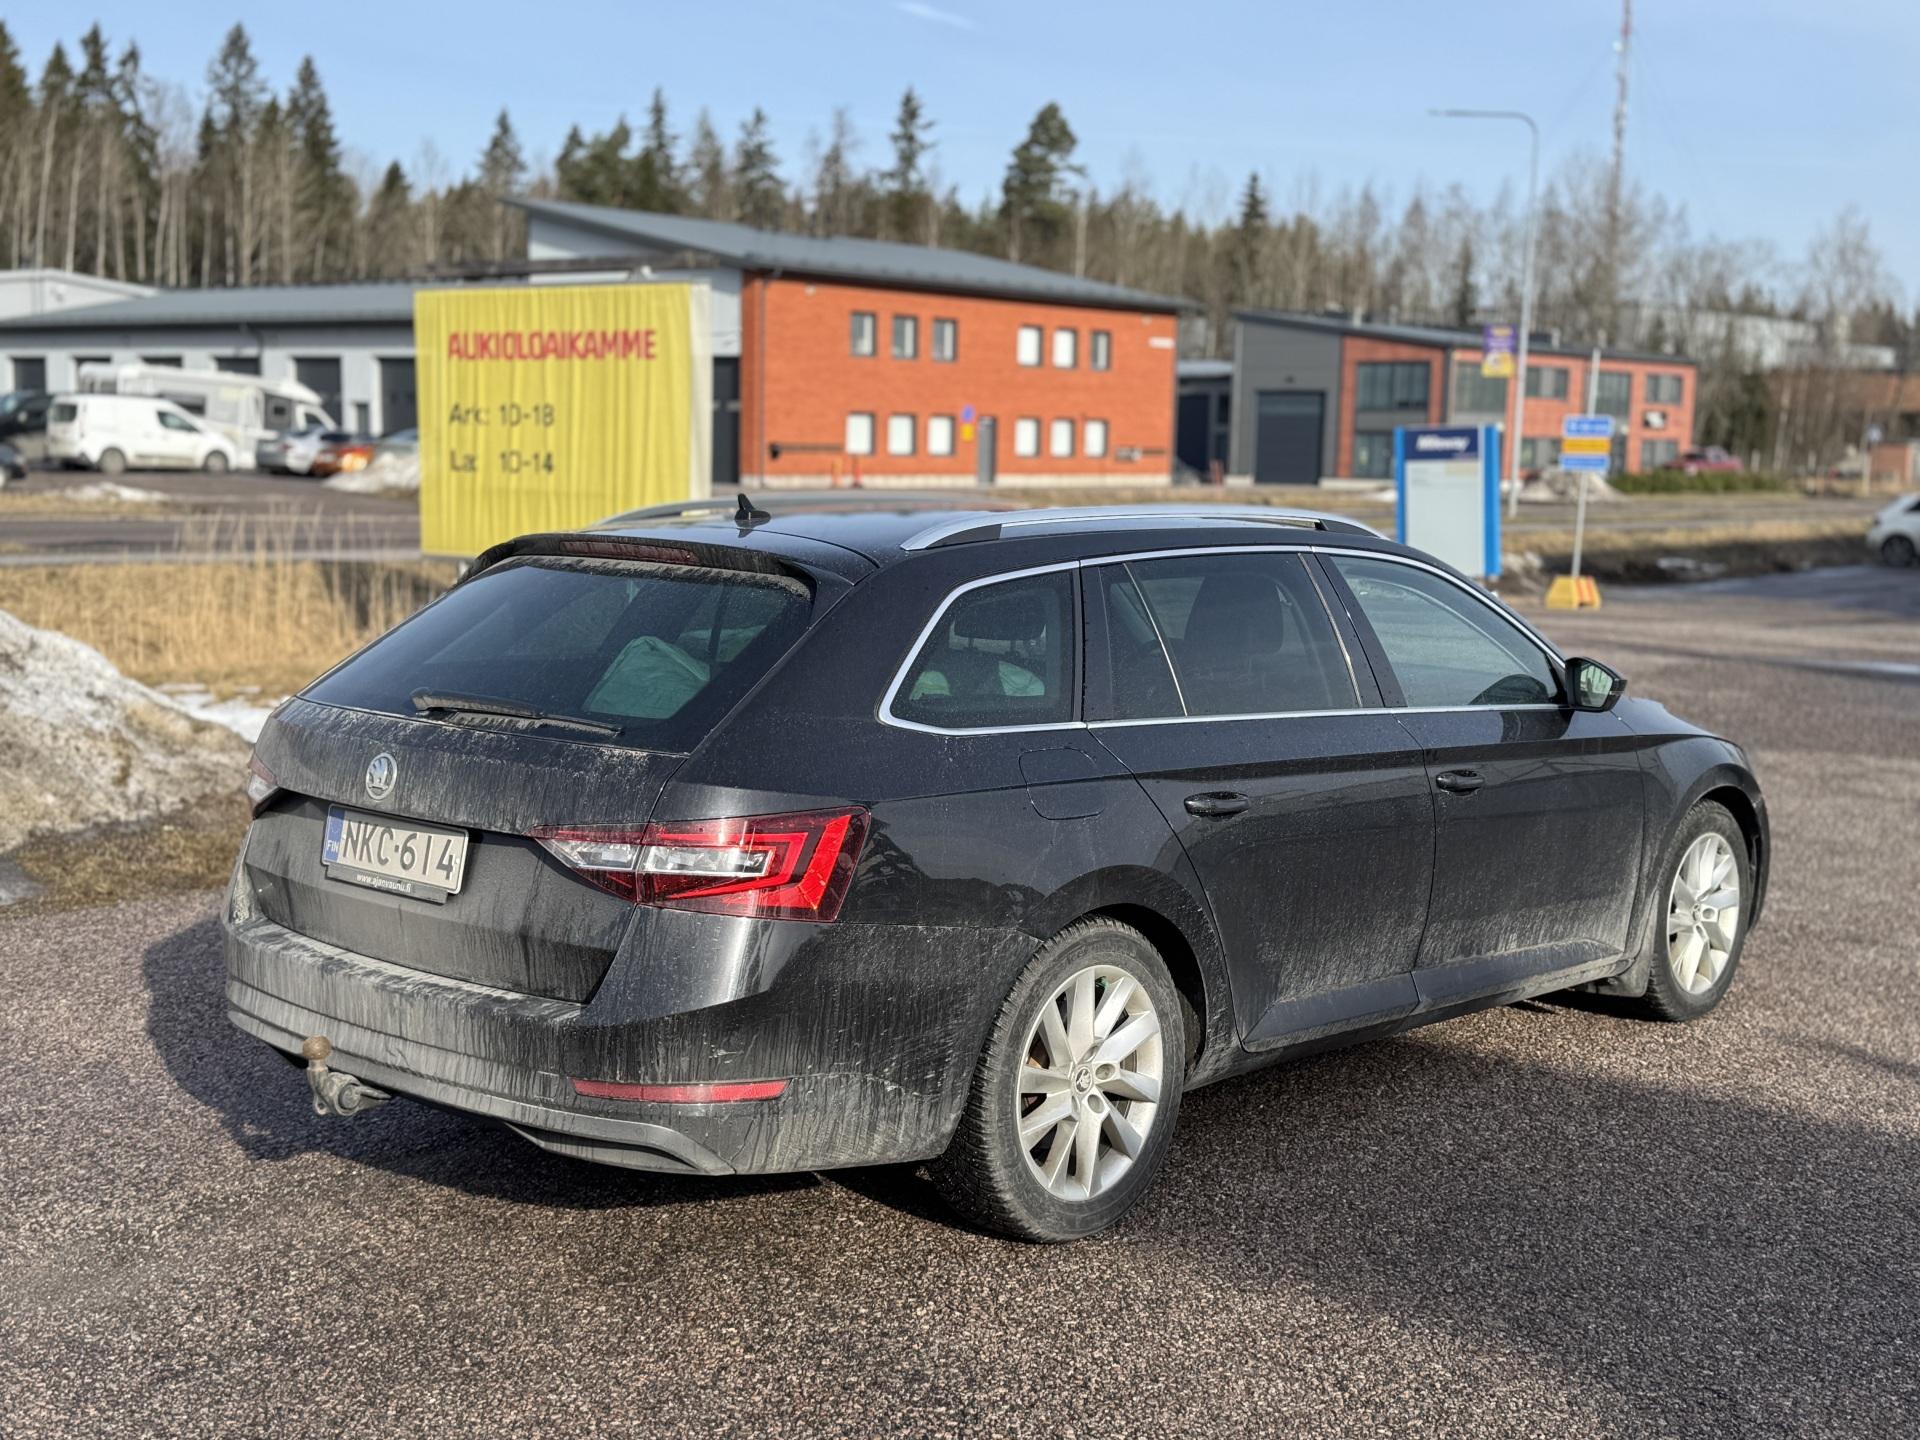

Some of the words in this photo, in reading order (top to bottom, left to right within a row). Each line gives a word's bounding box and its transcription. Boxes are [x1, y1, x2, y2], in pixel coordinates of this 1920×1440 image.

[448, 330, 656, 360] AUKIOLOAIKAMME
[499, 403, 555, 426] 10-18
[499, 451, 554, 472] 10-14
[342, 820, 454, 880] NKC-614
